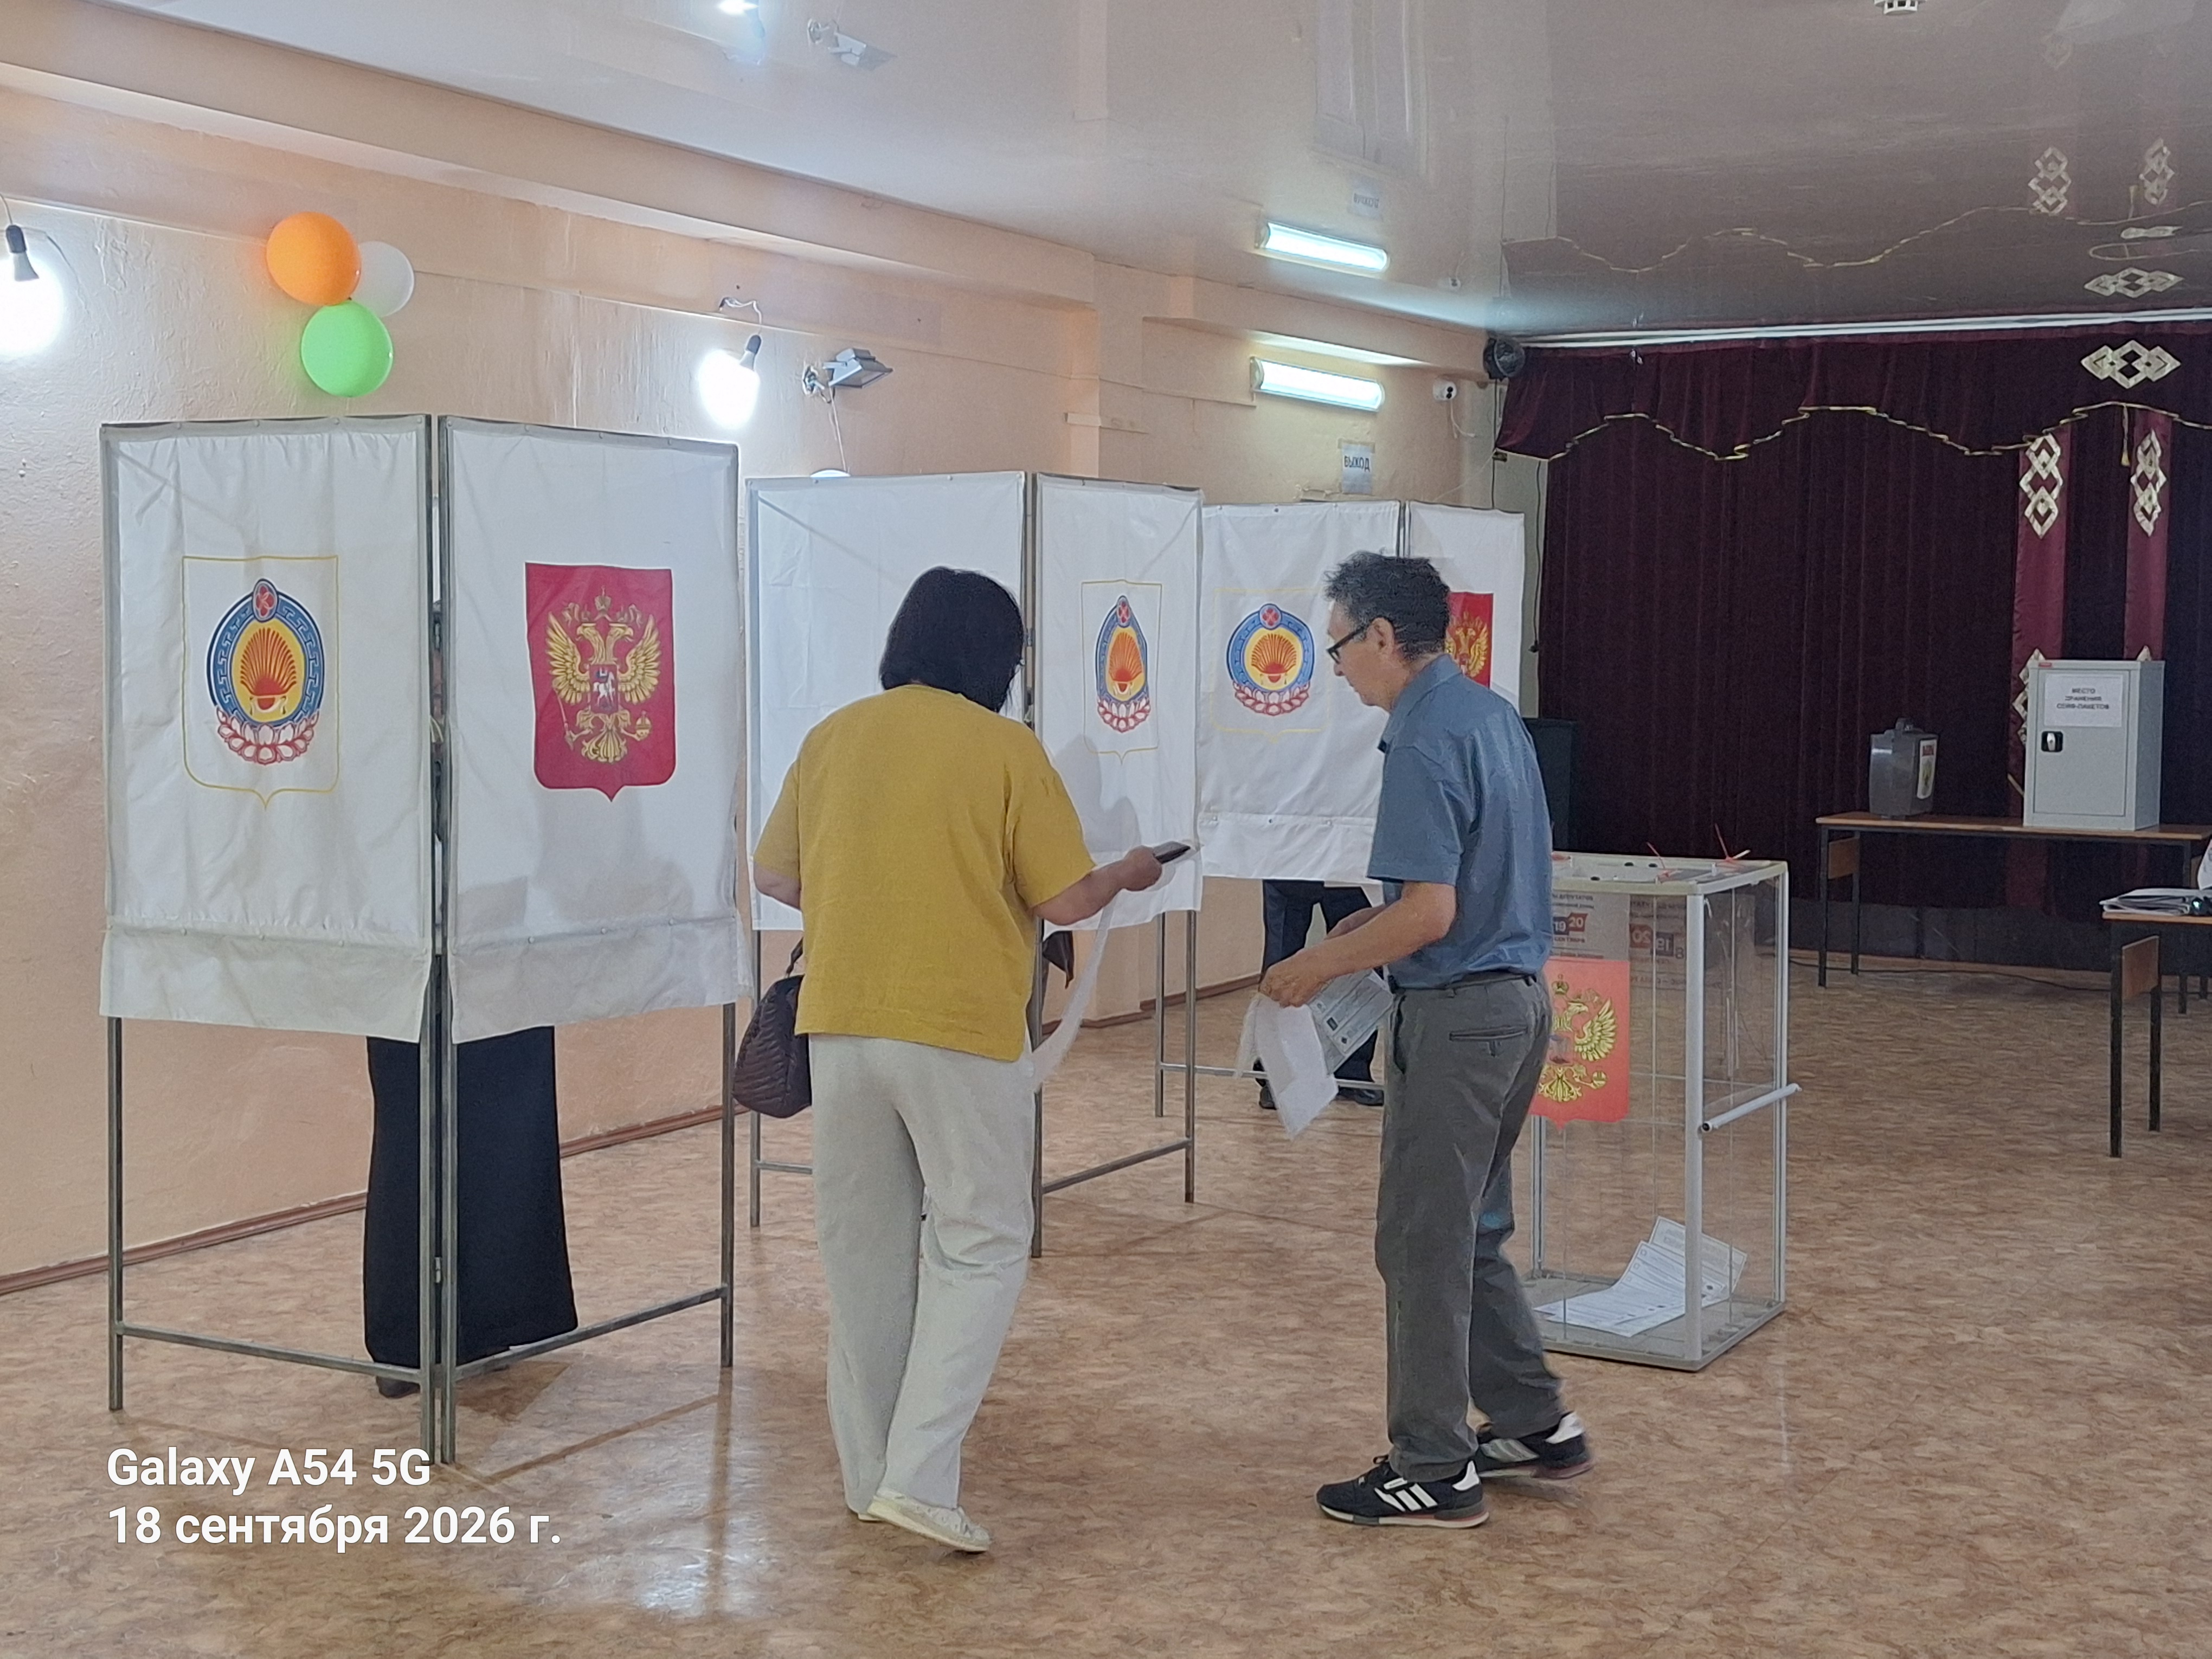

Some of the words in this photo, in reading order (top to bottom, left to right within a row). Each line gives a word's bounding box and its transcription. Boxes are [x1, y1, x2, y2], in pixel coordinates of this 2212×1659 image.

[1344, 455, 1370, 472] ВЫХОД
[1554, 921, 1566, 932] 19
[1568, 916, 1584, 928] 20
